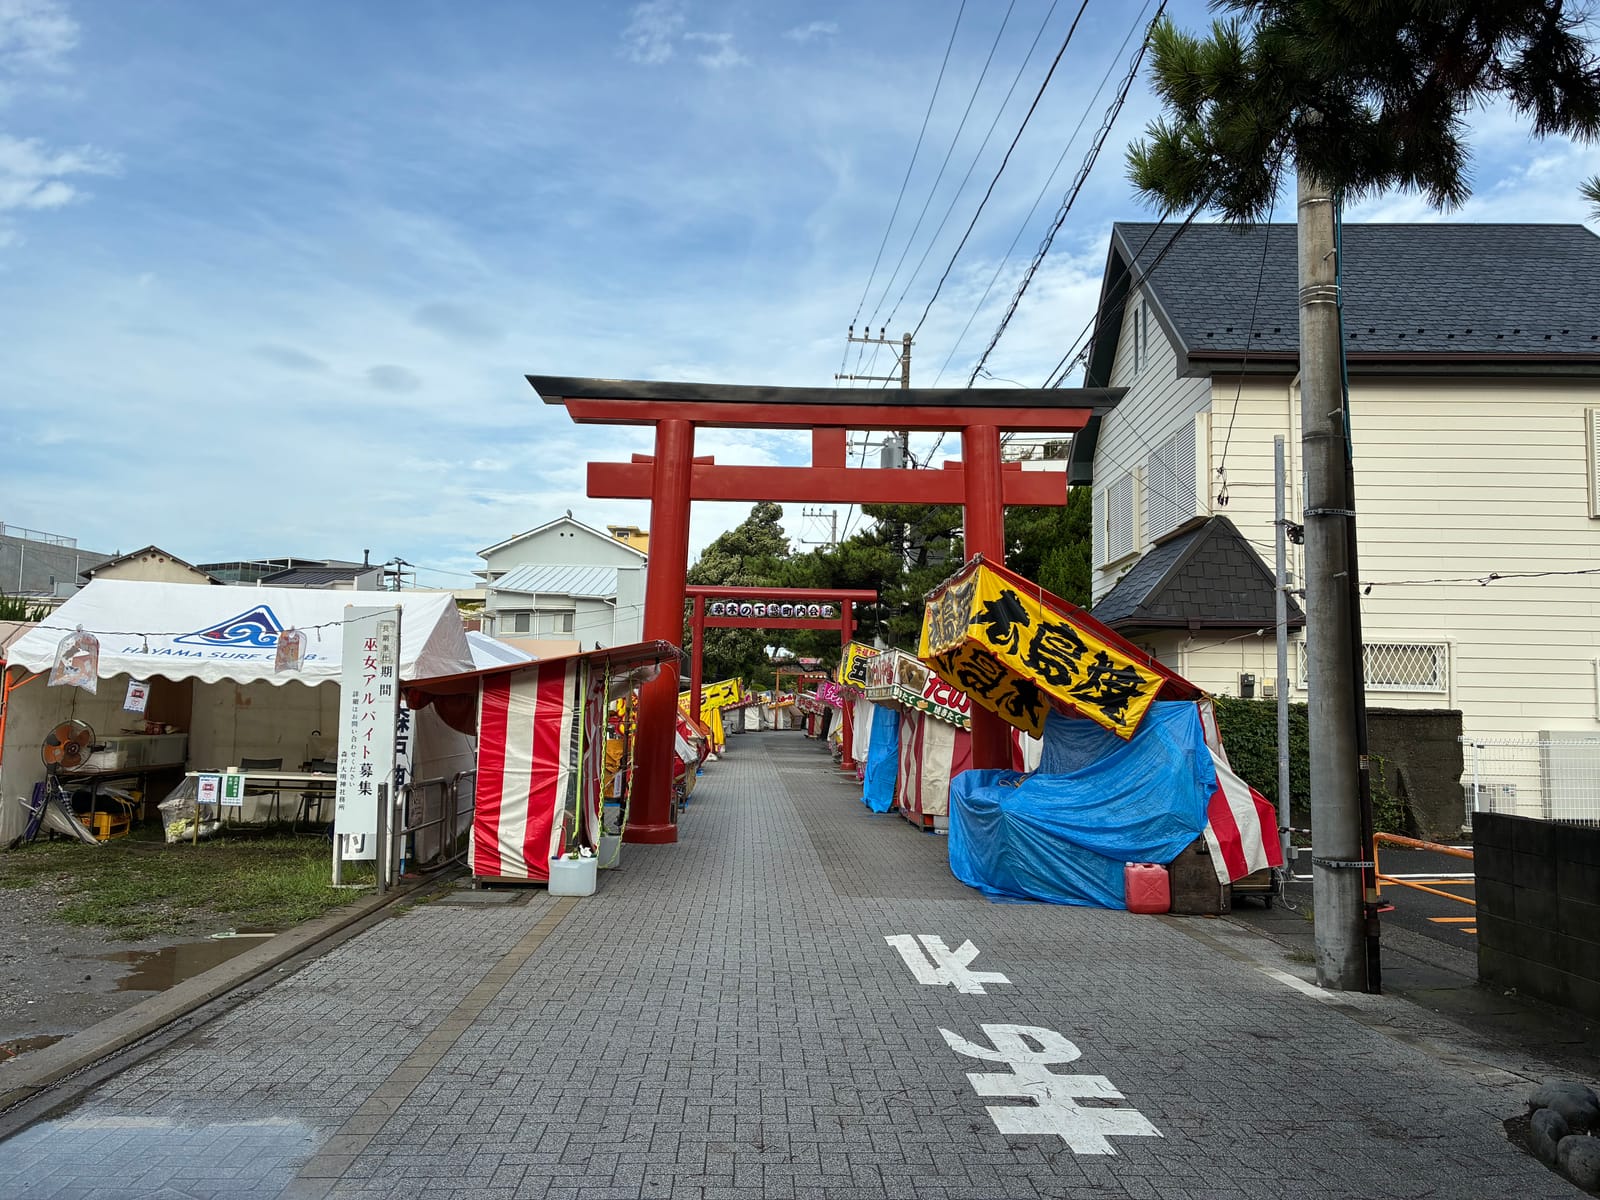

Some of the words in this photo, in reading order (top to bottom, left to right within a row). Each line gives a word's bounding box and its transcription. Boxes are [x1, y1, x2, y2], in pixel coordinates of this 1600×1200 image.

[208, 652, 262, 660] SURF
[266, 653, 317, 661] CB
[380, 666, 392, 696] 期間
[350, 691, 359, 787] 詳細はお問い合わせください
[358, 638, 377, 795] 巫女アルバイト募集
[338, 751, 347, 810] 森戸大明神社務所
